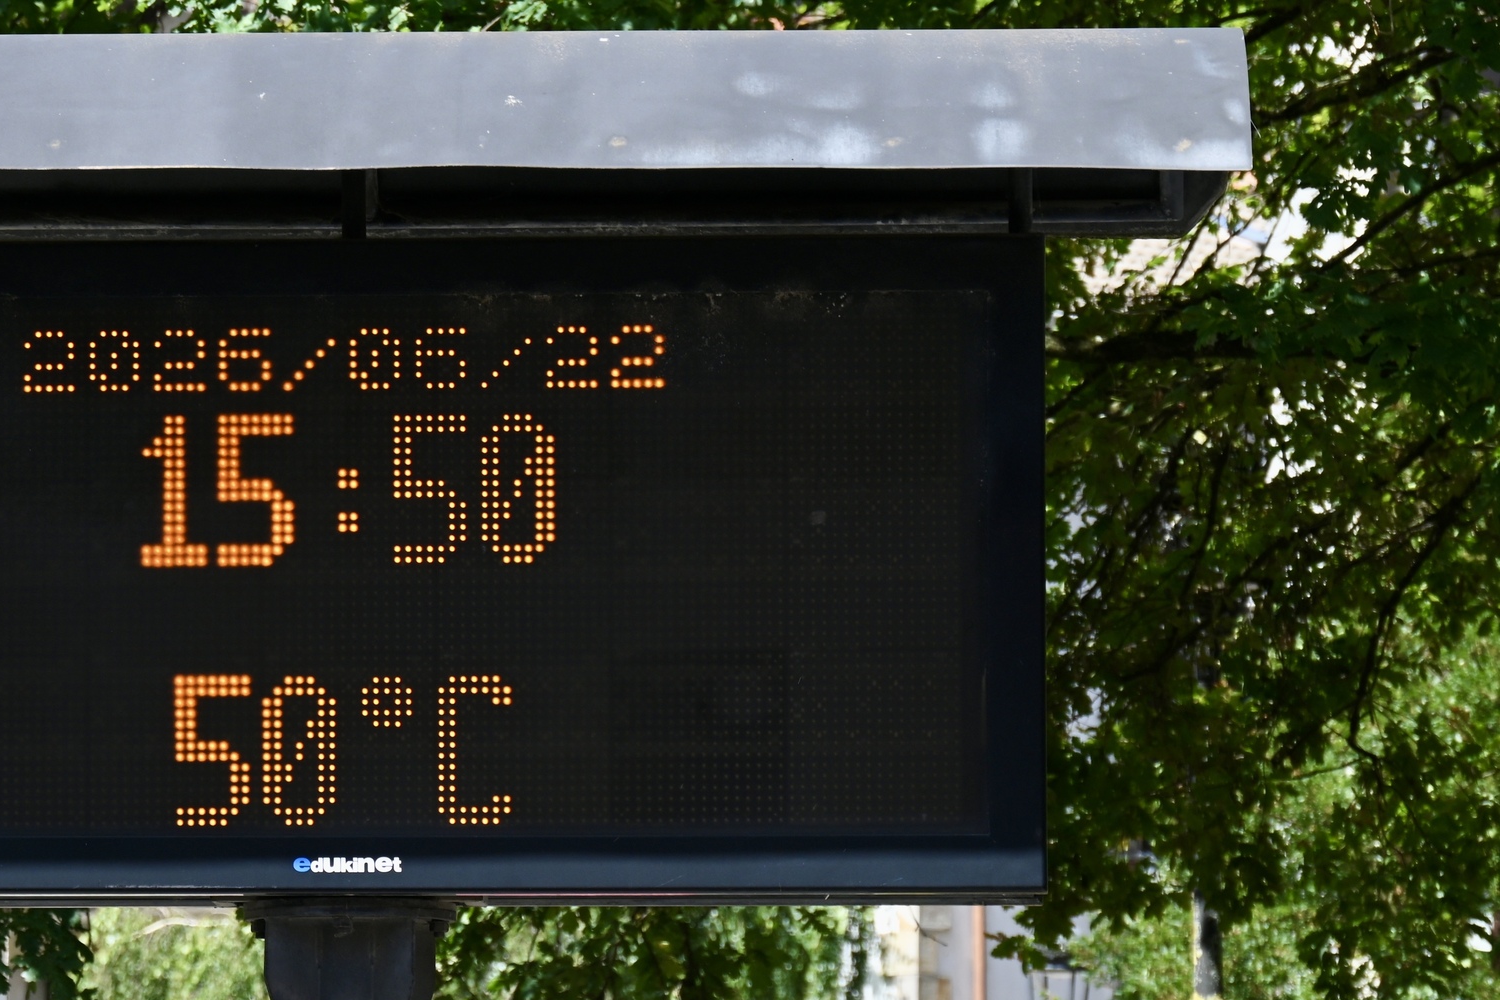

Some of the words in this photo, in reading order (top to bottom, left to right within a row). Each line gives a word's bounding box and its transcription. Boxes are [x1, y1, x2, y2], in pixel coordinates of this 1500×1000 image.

[22, 324, 666, 394] 2026/06/22
[140, 412, 556, 568] 15:50
[173, 674, 513, 828] 50°C
[292, 856, 403, 873] edukinet
